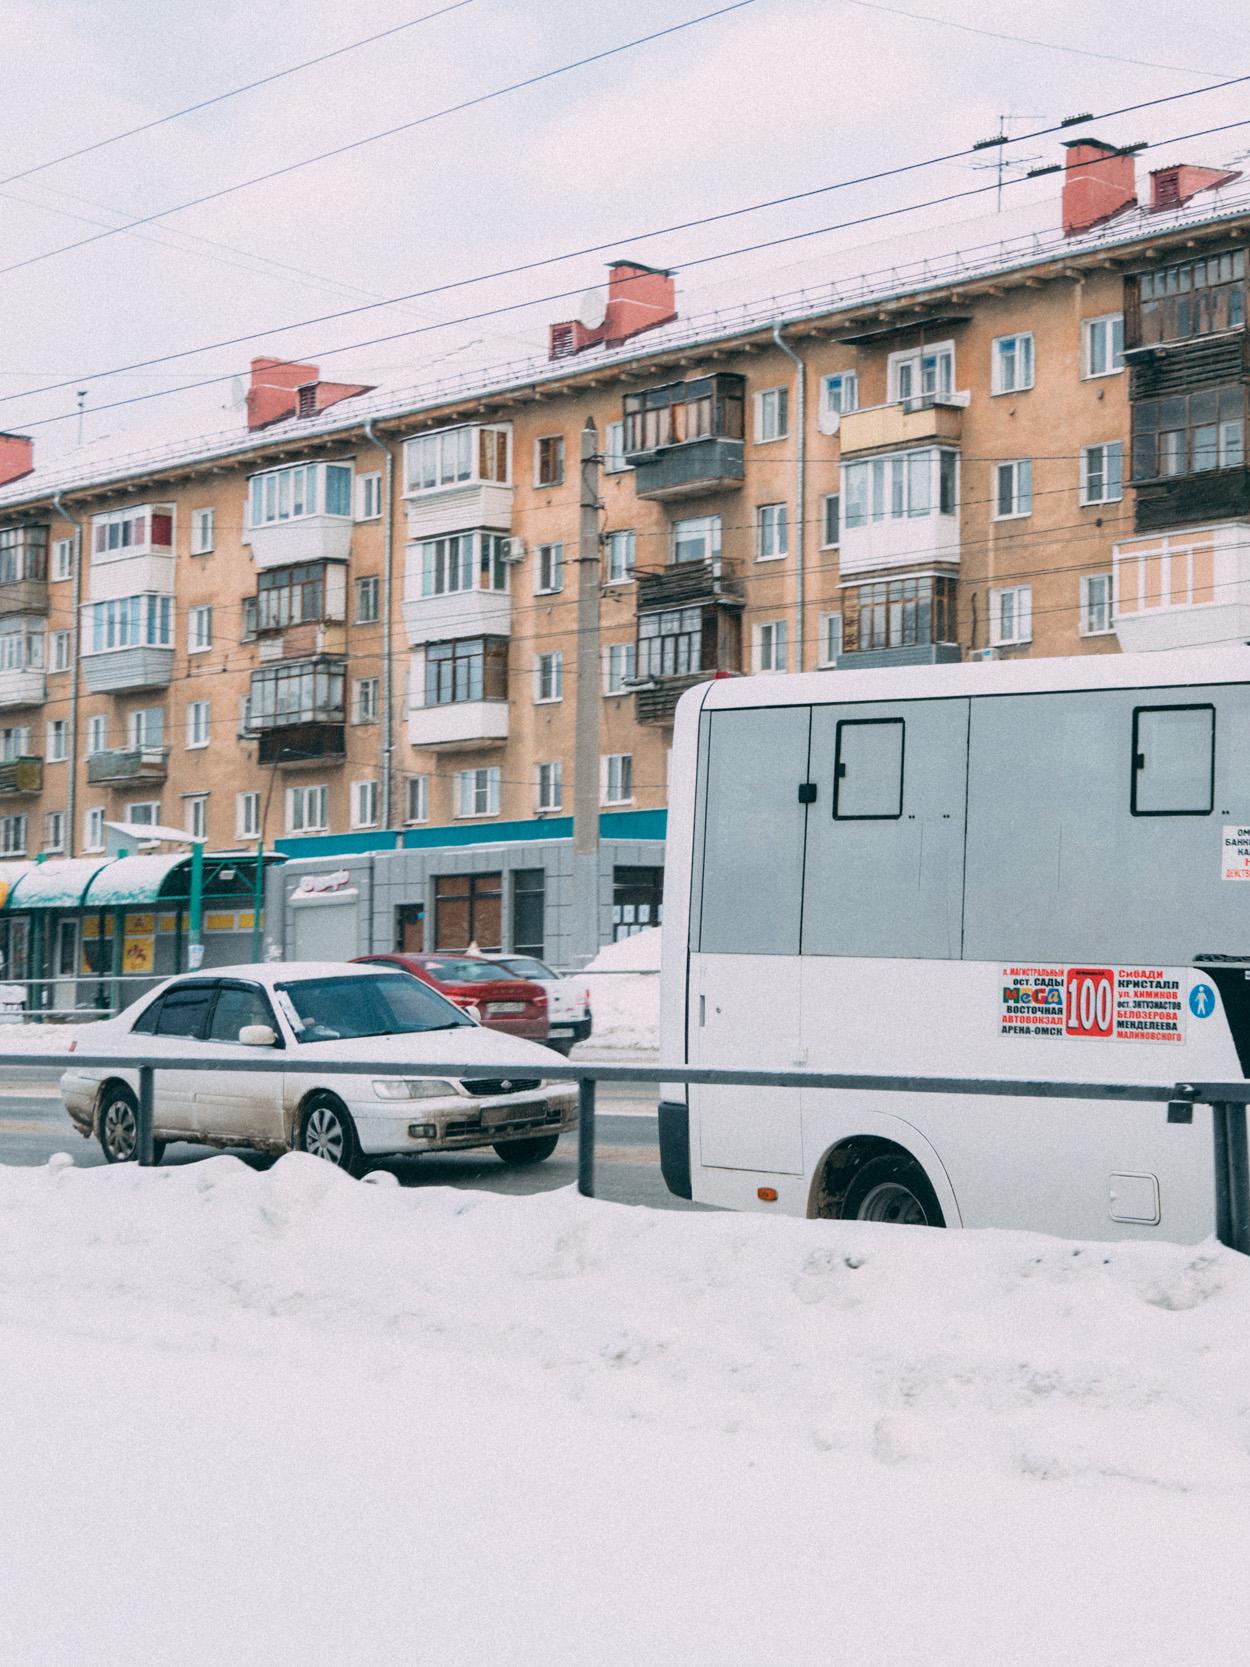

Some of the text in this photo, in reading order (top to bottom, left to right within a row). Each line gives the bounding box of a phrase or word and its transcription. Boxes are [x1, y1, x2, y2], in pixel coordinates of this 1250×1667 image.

[1009, 967, 1064, 977] МАГИСТРАЛЬНЫЙ
[1034, 977, 1064, 987] САДЫ
[1118, 979, 1179, 989] КРИСТАЛЛ
[1133, 990, 1178, 1000] ХИМИКОВ
[1067, 977, 1113, 1031] 100
[1132, 1000, 1181, 1010] ЭНТУЗИАСТОВ
[1007, 1005, 1063, 1015] ВОСТОЧНАЯ
[1117, 1010, 1178, 1020] БЕЛОЗЕРОВА
[1002, 1015, 1063, 1025] АВТОВОКЗАЛ
[1117, 1020, 1178, 1031] МЕНДЕЛЕЕВА
[1001, 1026, 1063, 1036] АРЕНА-ОМСК
[1117, 1031, 1182, 1041] МАЛИНОВСКОГО
